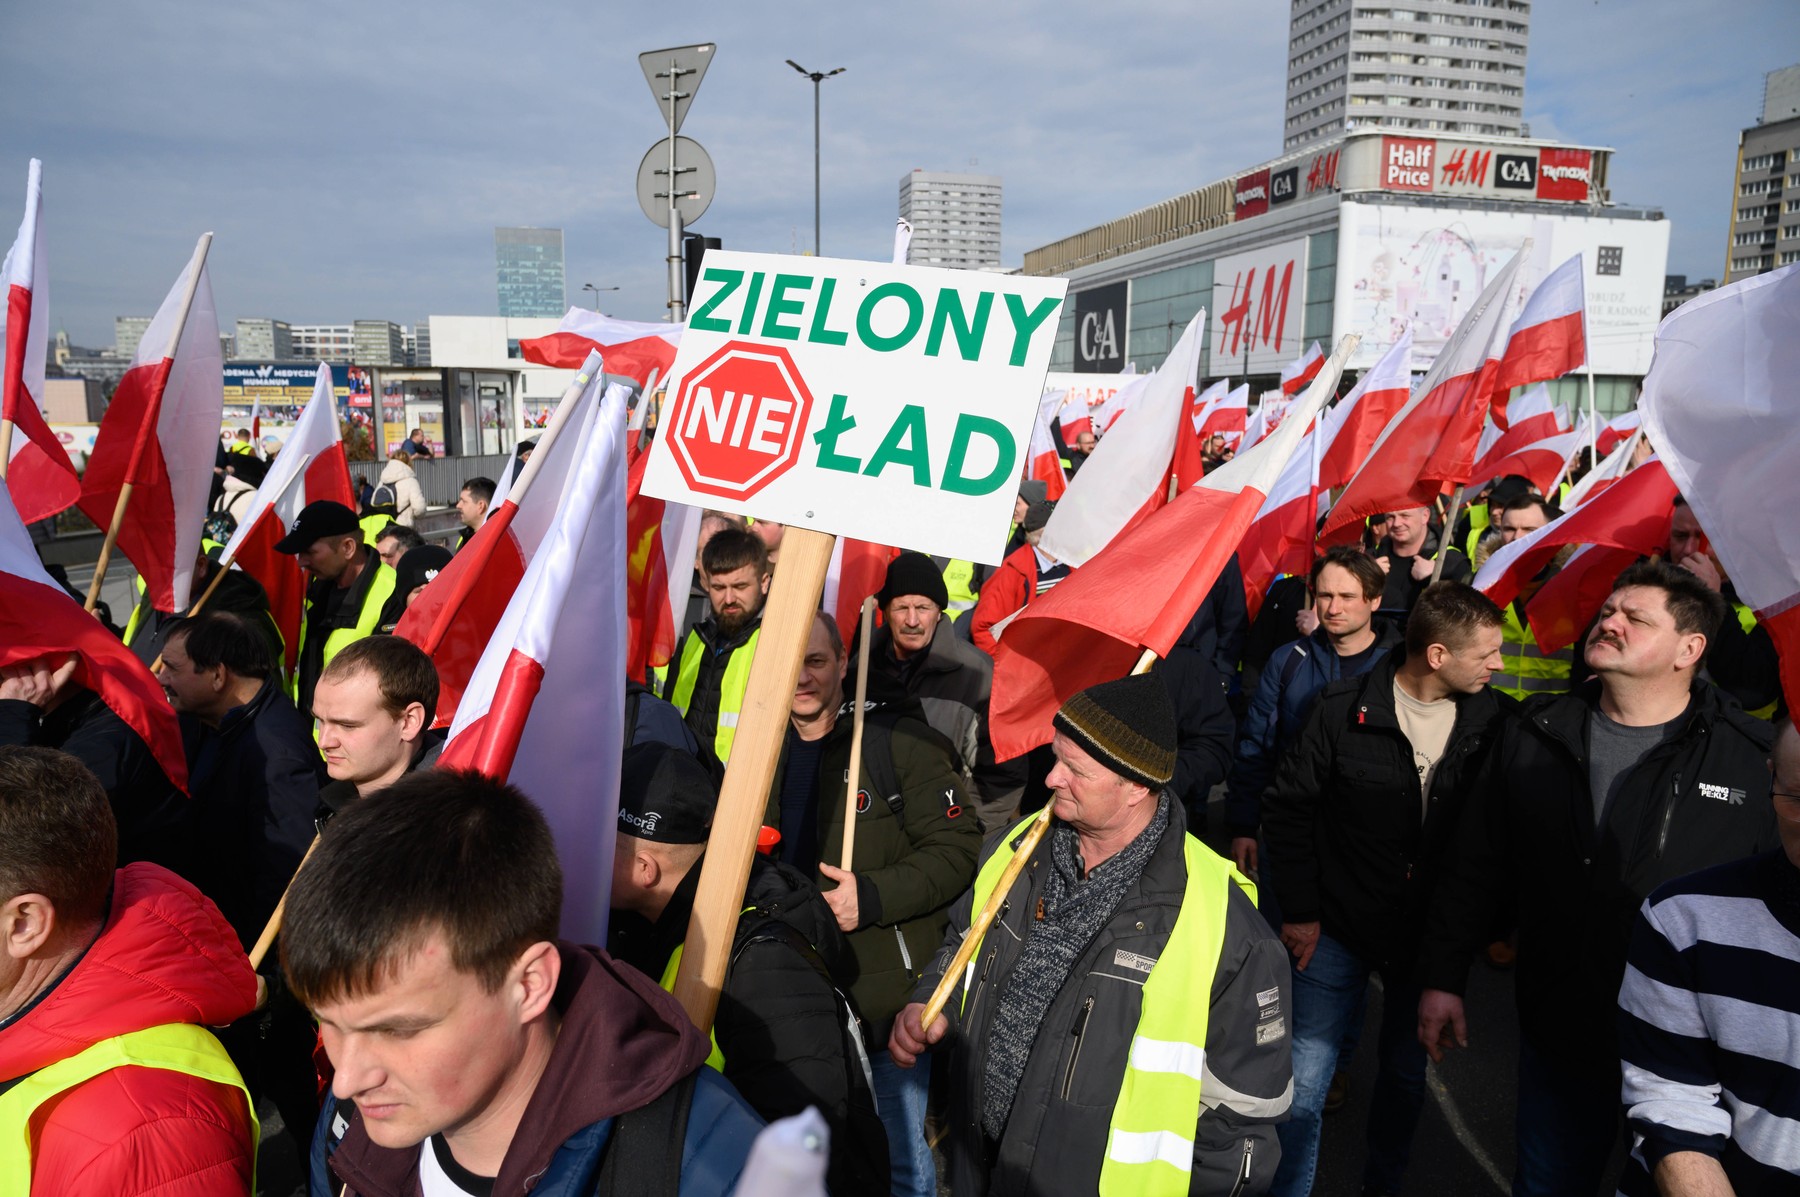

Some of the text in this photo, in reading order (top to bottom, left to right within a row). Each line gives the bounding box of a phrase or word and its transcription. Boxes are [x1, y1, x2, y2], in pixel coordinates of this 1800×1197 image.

[1306, 148, 1341, 192] H&M
[1390, 144, 1432, 167] Half
[1440, 147, 1492, 188] H&M
[1501, 160, 1532, 182] C&A
[1273, 176, 1293, 197] C&A
[1388, 166, 1430, 187] Price
[688, 267, 1064, 368] ZIELONY
[1219, 259, 1294, 358] H&M
[1080, 309, 1119, 362] C&A
[684, 386, 1017, 497] NIE ŁAD
[1698, 782, 1730, 794] RUNNING
[618, 808, 656, 831] Ascra
